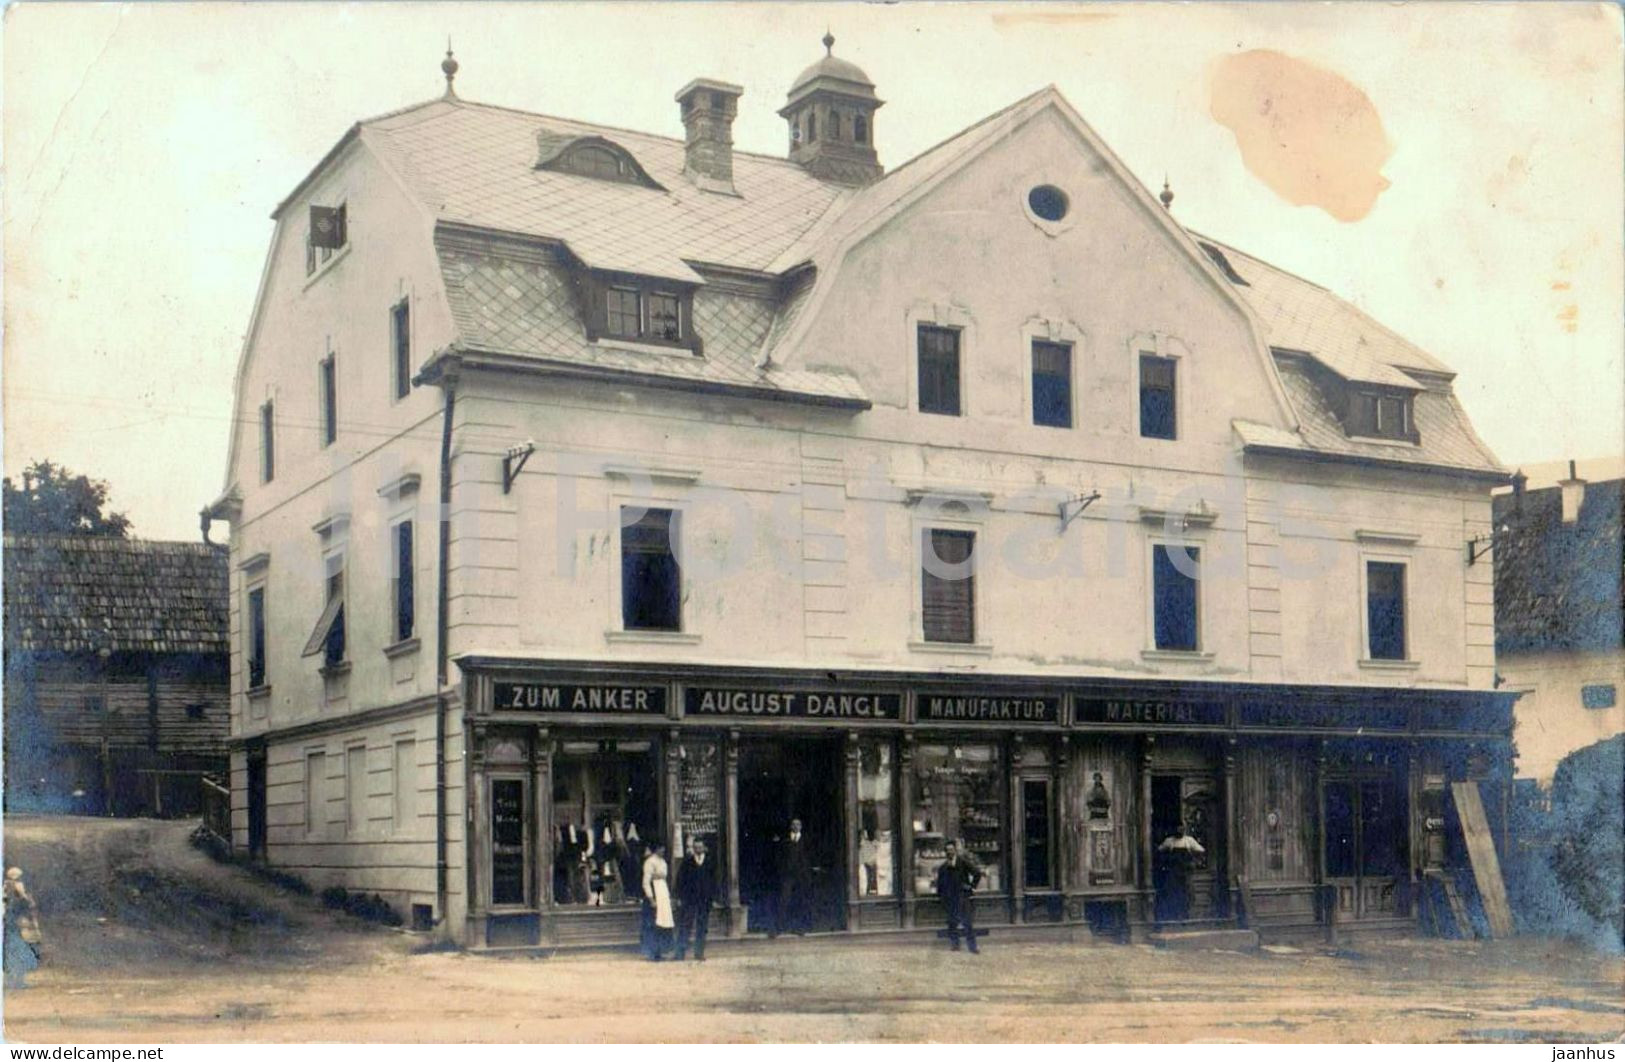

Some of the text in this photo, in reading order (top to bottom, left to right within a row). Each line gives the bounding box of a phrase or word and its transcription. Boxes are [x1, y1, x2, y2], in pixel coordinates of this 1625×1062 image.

[512, 686, 649, 710] ZUM ANKER
[700, 690, 886, 717] AUGUST DANGL
[930, 698, 1046, 719] MANUFAKTUR
[1106, 702, 1196, 720] MATERIAL
